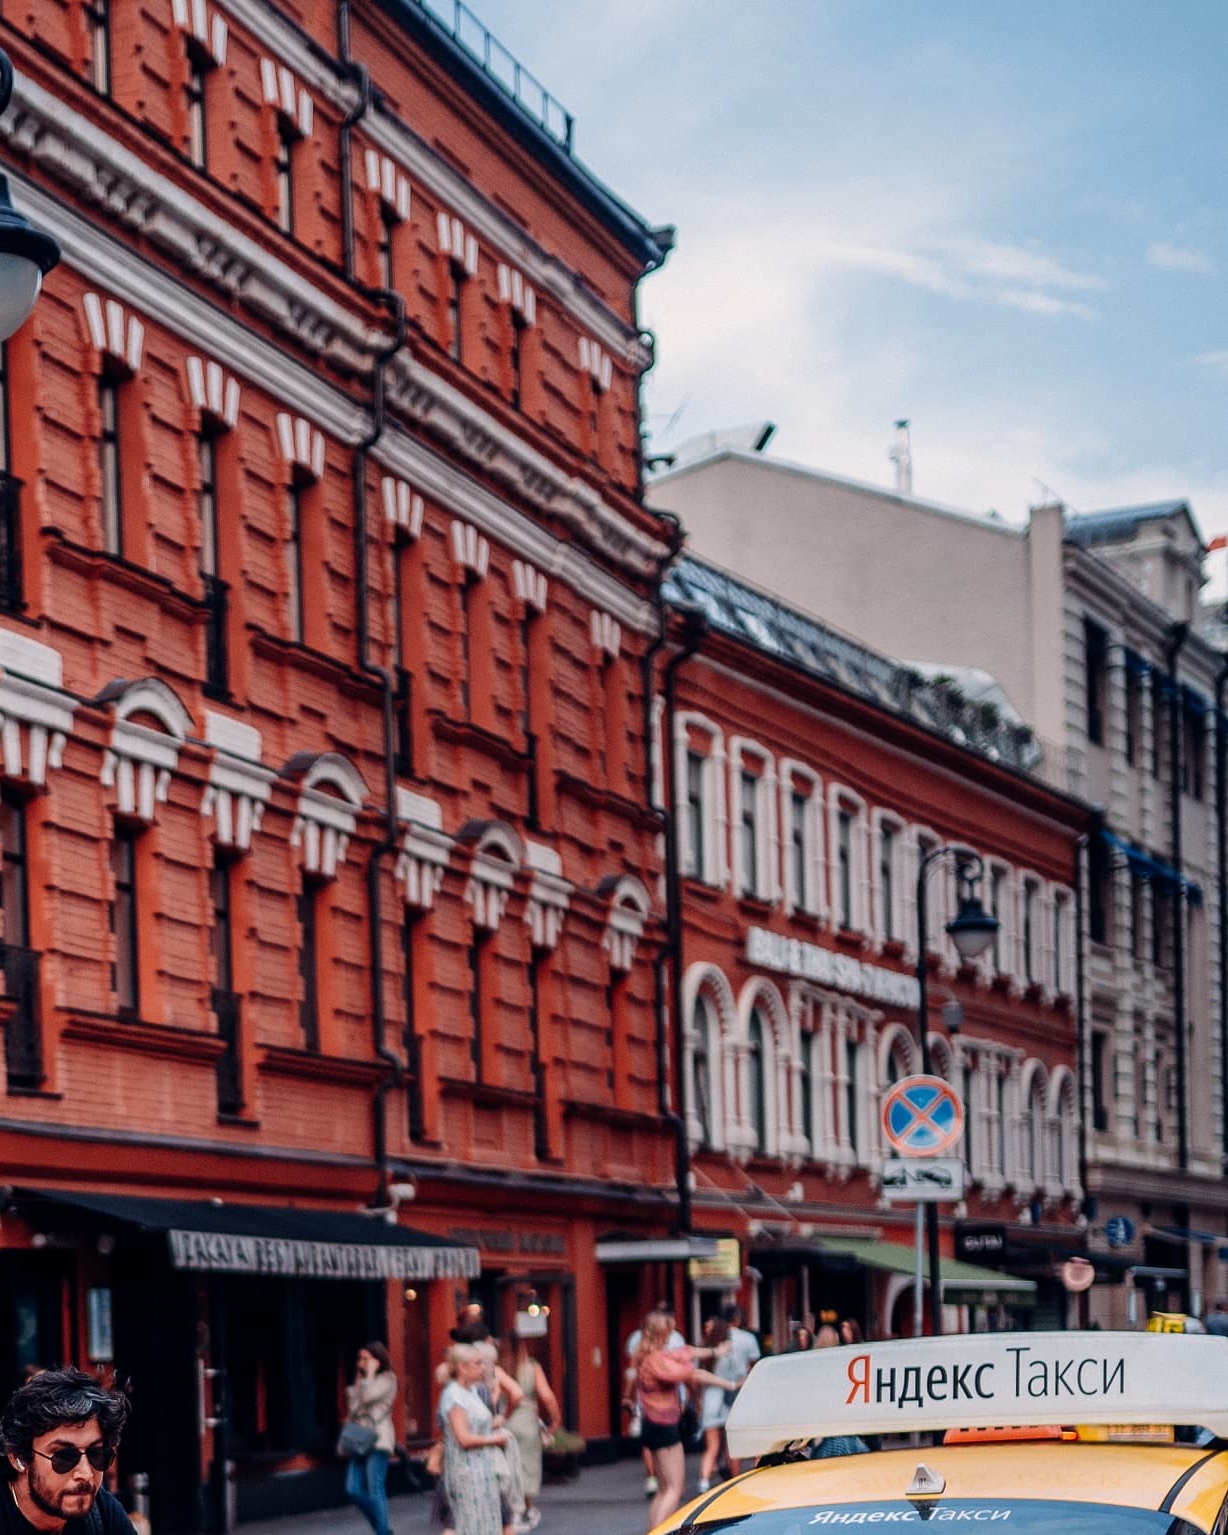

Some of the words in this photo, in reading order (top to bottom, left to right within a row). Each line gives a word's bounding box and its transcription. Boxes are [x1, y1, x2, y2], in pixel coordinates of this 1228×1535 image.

[845, 1354, 995, 1409] Яндекс
[1006, 1347, 1125, 1398] Такси
[808, 1510, 917, 1525] Яндекс
[927, 1507, 1012, 1522] Такси
